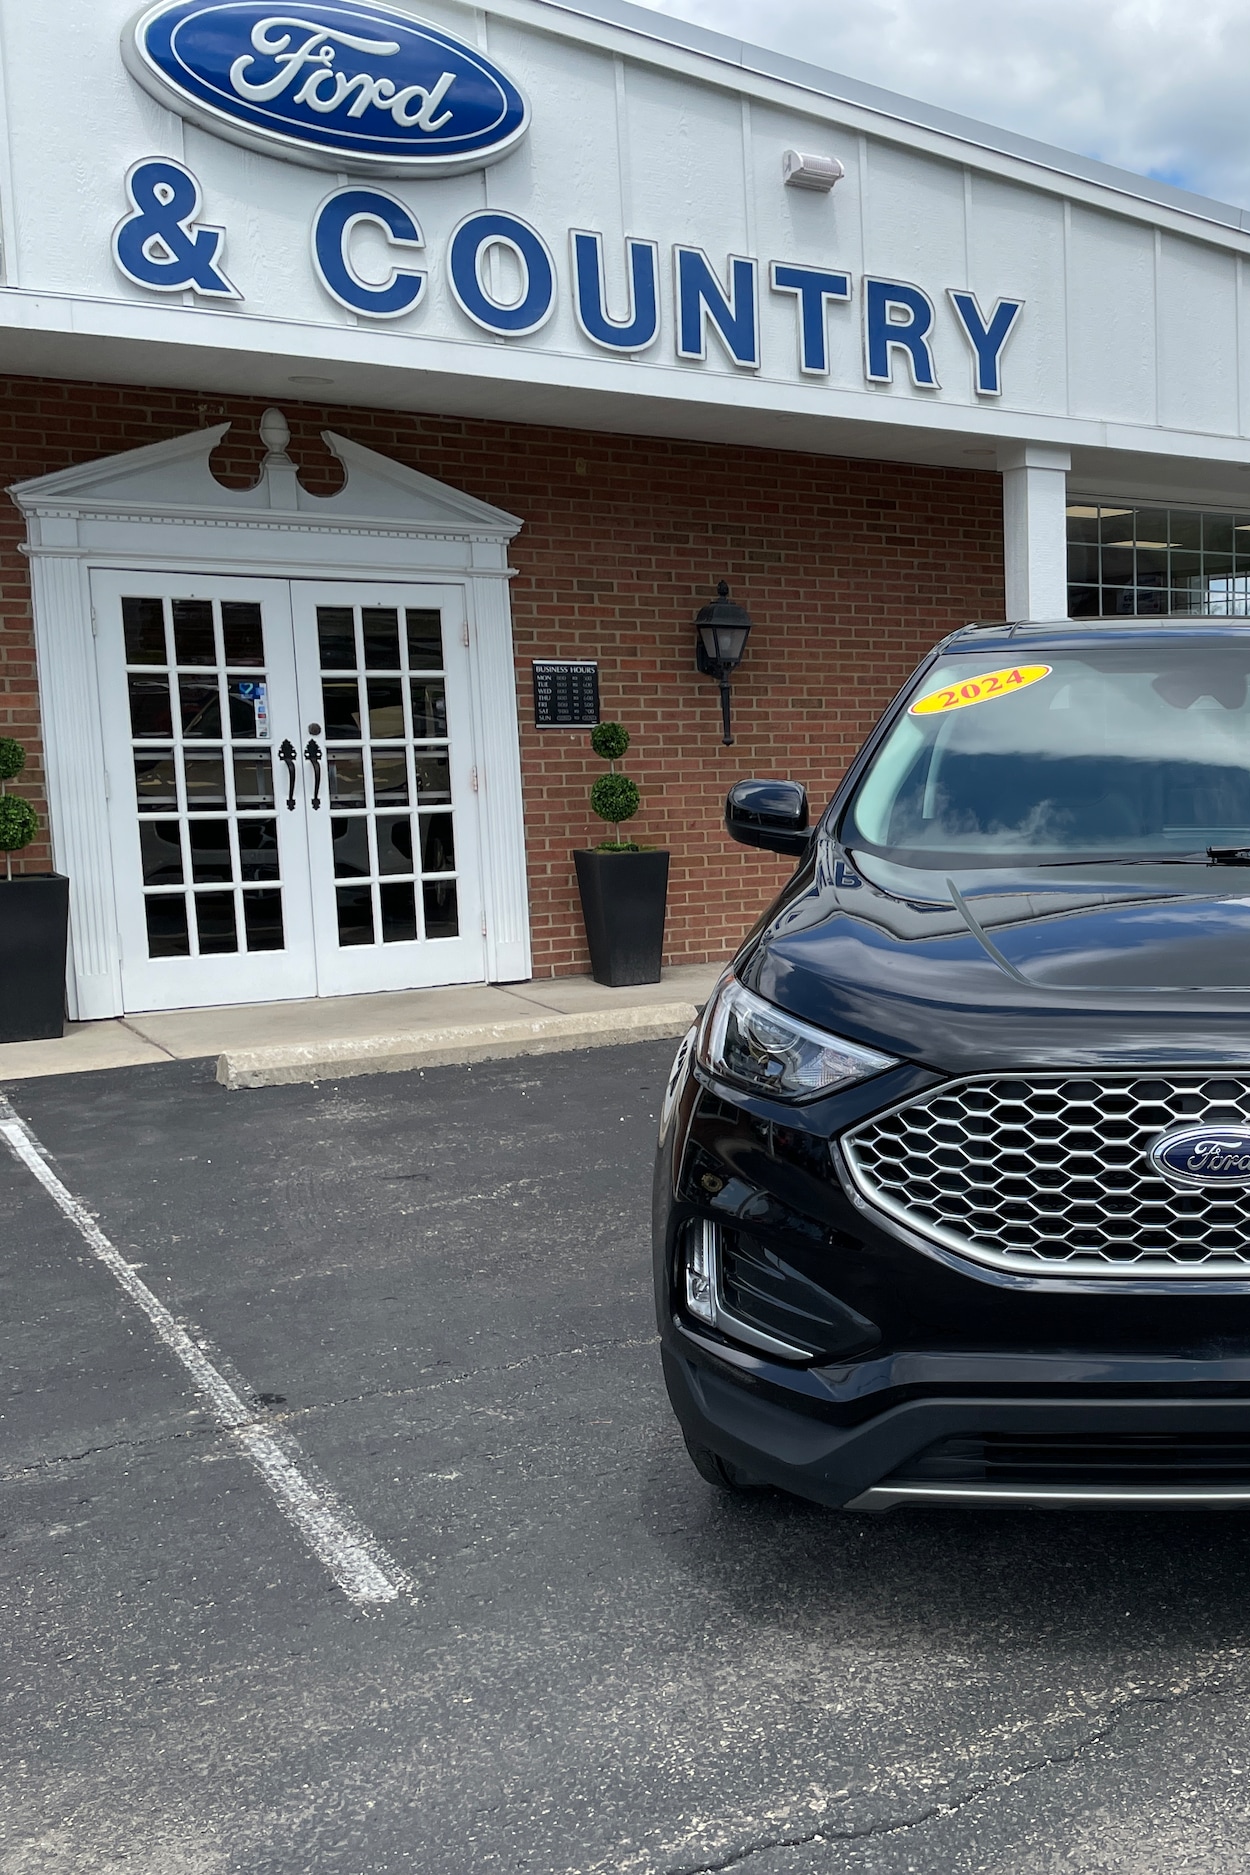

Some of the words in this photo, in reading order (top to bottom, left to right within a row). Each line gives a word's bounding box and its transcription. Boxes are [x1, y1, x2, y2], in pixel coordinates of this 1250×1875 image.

[229, 16, 457, 133] Ford
[112, 156, 245, 301] &
[311, 185, 1026, 396] COUNTRY
[535, 665, 569, 673] BUSINESS
[570, 666, 596, 674] HOURS
[937, 669, 1025, 708] 2024
